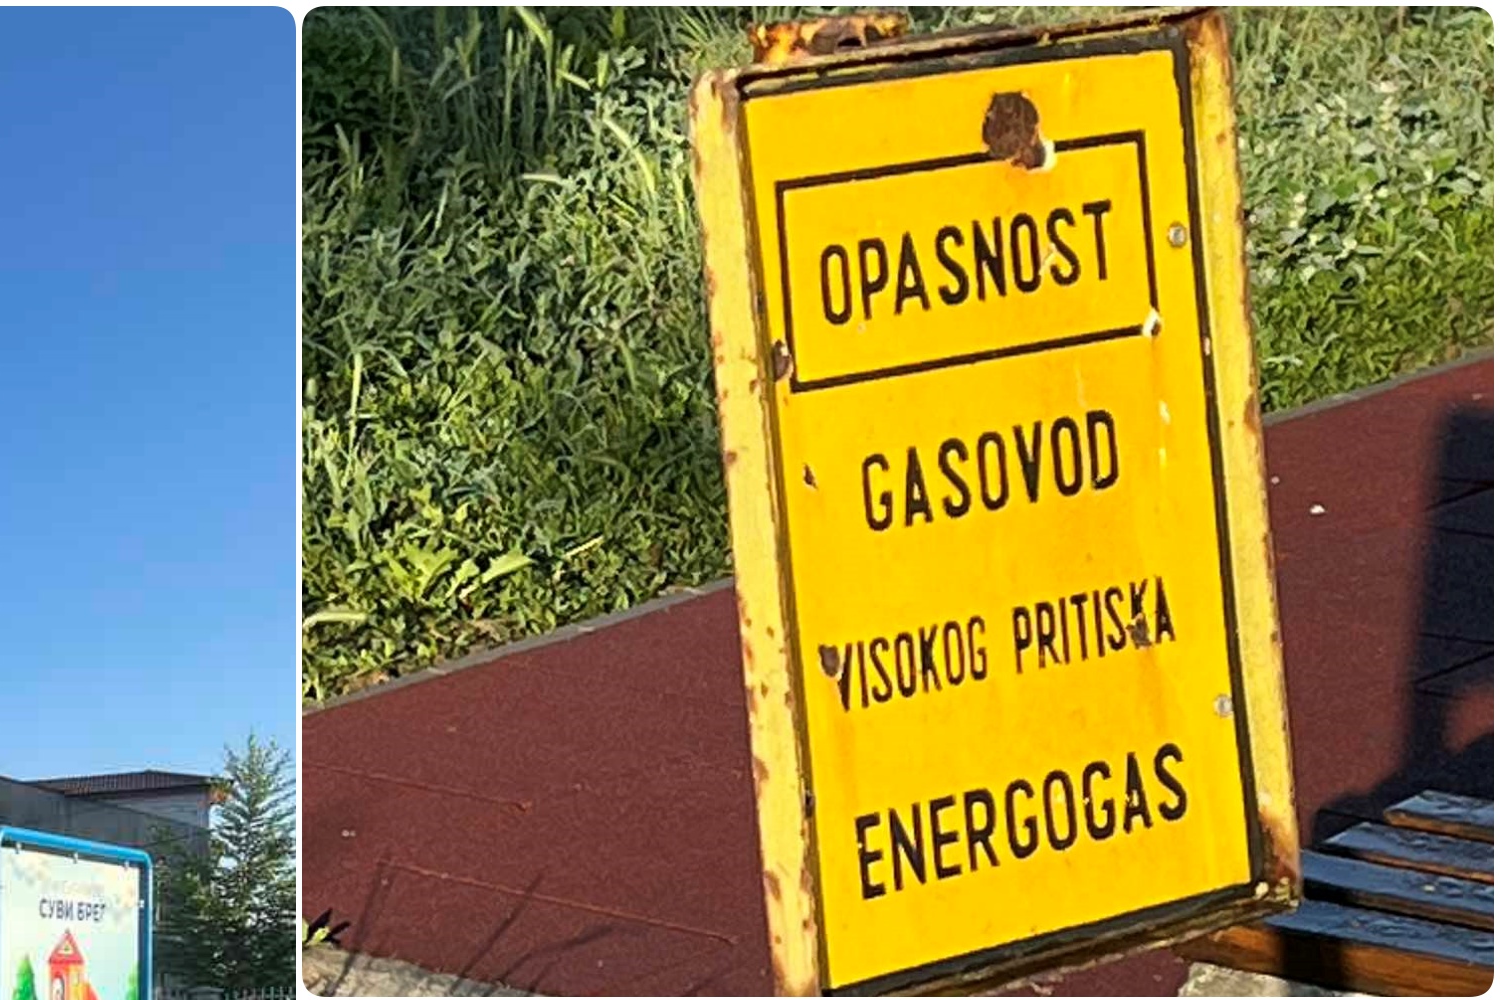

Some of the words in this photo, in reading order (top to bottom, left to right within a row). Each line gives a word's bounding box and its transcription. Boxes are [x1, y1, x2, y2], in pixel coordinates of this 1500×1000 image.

[820, 198, 1112, 326] OPASNOST
[861, 409, 1120, 532] GASOVOD
[1012, 575, 1176, 674] PRITISKA
[855, 743, 1188, 900] ENERGOGAS
[38, 898, 74, 921] СУВИ
